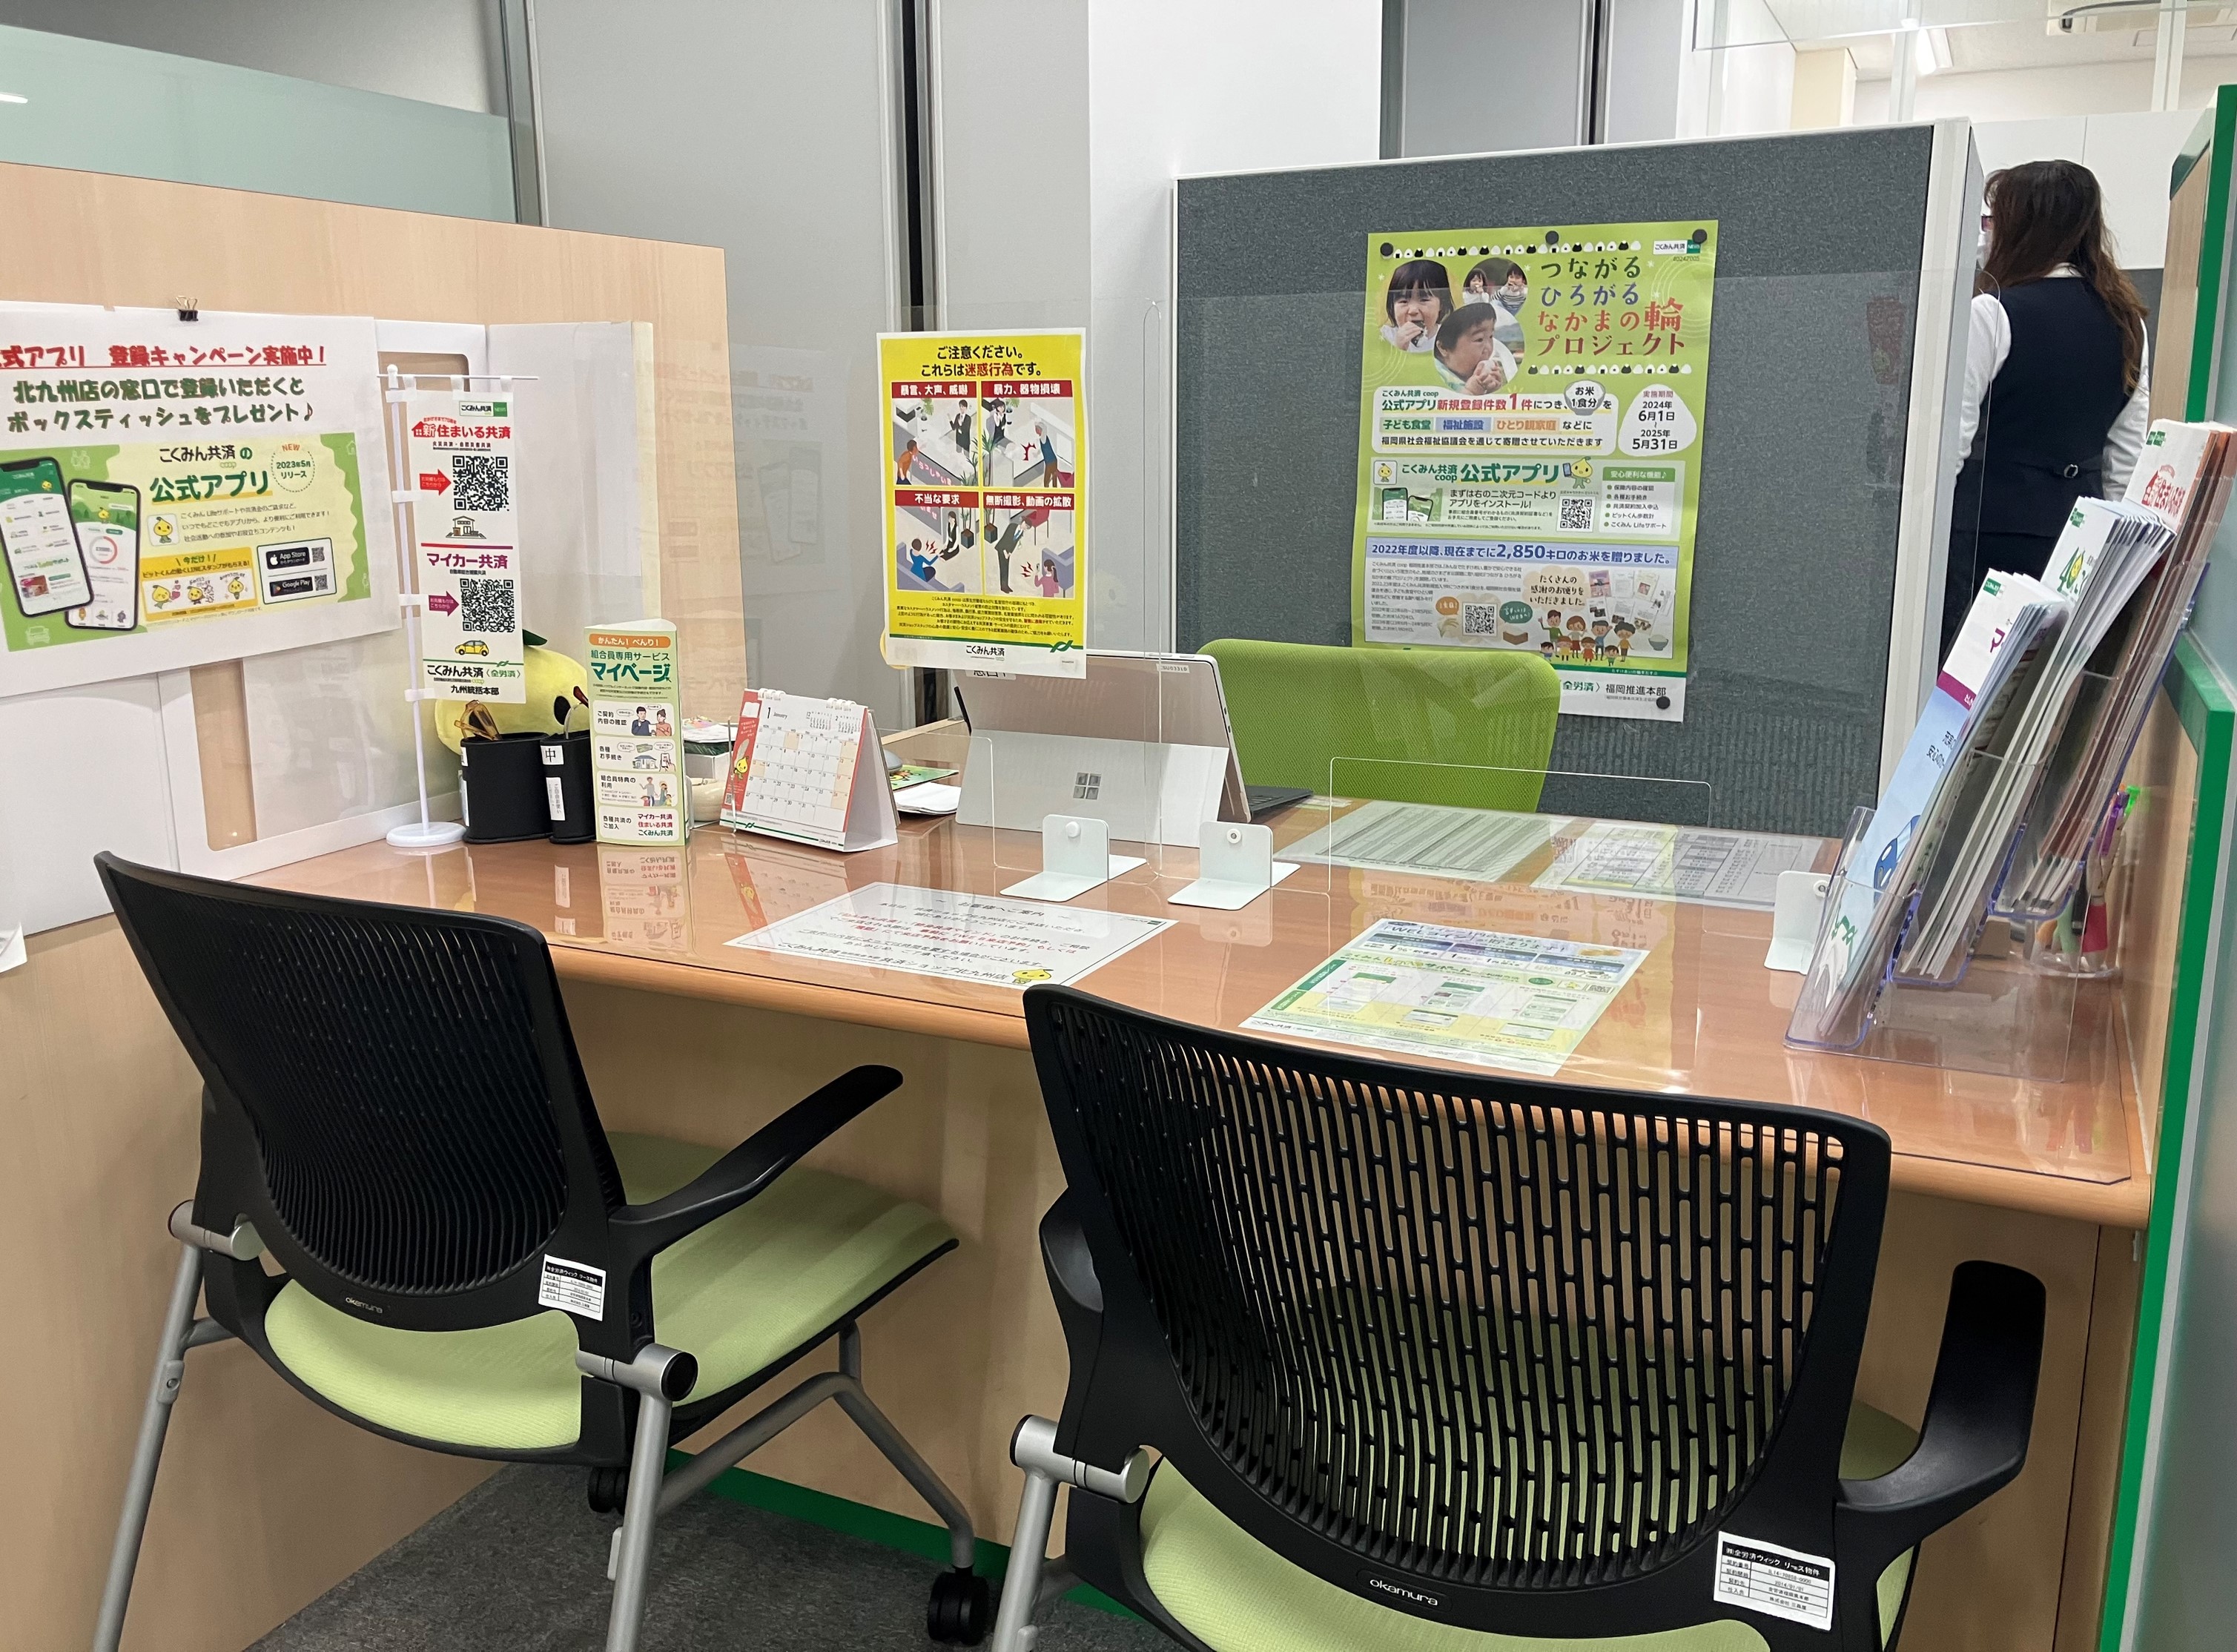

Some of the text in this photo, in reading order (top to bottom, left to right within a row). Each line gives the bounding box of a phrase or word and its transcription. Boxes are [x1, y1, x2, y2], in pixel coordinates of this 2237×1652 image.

[1541, 256, 1641, 280] つながる
[1541, 283, 1639, 306] ひろがる
[1538, 297, 1684, 332] なかまの輪
[1537, 333, 1685, 356] プロジェクト
[0, 345, 85, 367] 式アプリ
[937, 346, 1022, 360] ご注意ください。
[921, 362, 1042, 377] これらは迷惑行為です。
[13, 377, 305, 403] 北九州店の窓口で登録いただくと
[900, 385, 968, 396] 暴言、大声、威嚇
[994, 383, 1060, 394] 暴力、器物損壊
[1576, 387, 1594, 396] お米
[1571, 398, 1596, 408] 1食分
[1638, 410, 1675, 421] 6月1日
[1383, 420, 1592, 431] 子ども食堂 福祉施設 ひとり親家庭 などに
[282, 443, 300, 452] NEW
[1632, 439, 1677, 449] 5月31日
[159, 445, 253, 463] こくみん共済 の
[276, 460, 311, 469] 2023年5月
[1402, 464, 1457, 474] こくみん共済
[280, 471, 307, 479] リリース
[1435, 474, 1457, 483] coop
[1460, 463, 1559, 483] 公式アプリ
[149, 470, 269, 502] 公式アプリ
[914, 493, 960, 505] 不当な要求
[1450, 489, 1556, 499] まずは右の二次元コードより
[985, 495, 1072, 508] 無断撮影、動画の拡散
[280, 550, 306, 561] App Store
[426, 553, 508, 569] マイカー共済
[282, 580, 311, 589] Google Play
[1539, 575, 1577, 584] たくさんの
[1530, 585, 1584, 595] 感謝のお便りを
[591, 650, 670, 661] 組合員専用サービス
[966, 645, 1005, 656] こくみん共済
[427, 665, 483, 678] こくみん共済
[591, 662, 670, 682] マイページ
[1606, 684, 1667, 696] 福岡推進本部
[767, 707, 771, 718] 1
[545, 747, 555, 762] 中
[1370, 1579, 1438, 1605] okamura
